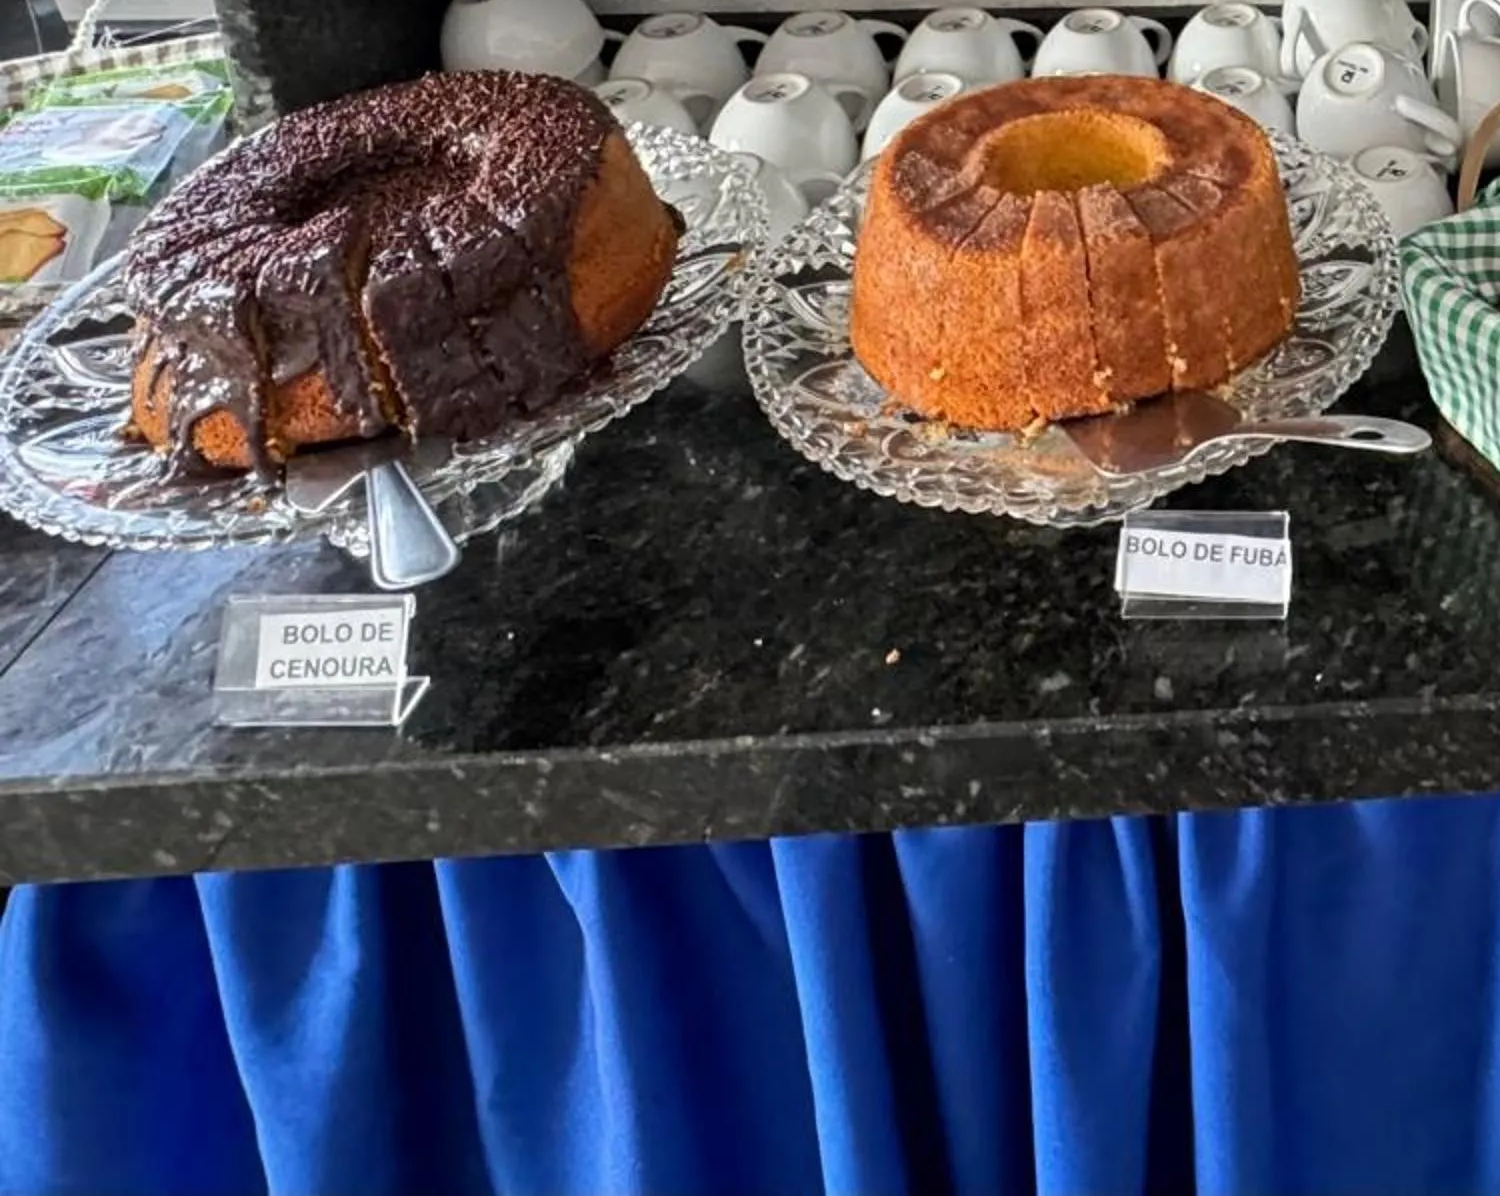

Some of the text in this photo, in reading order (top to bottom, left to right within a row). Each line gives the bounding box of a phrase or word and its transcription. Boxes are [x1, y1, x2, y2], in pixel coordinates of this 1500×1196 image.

[1126, 535, 1288, 567] BOLO DE FUBÁ
[282, 622, 395, 645] BOLO DE
[269, 655, 394, 680] CENOURA
